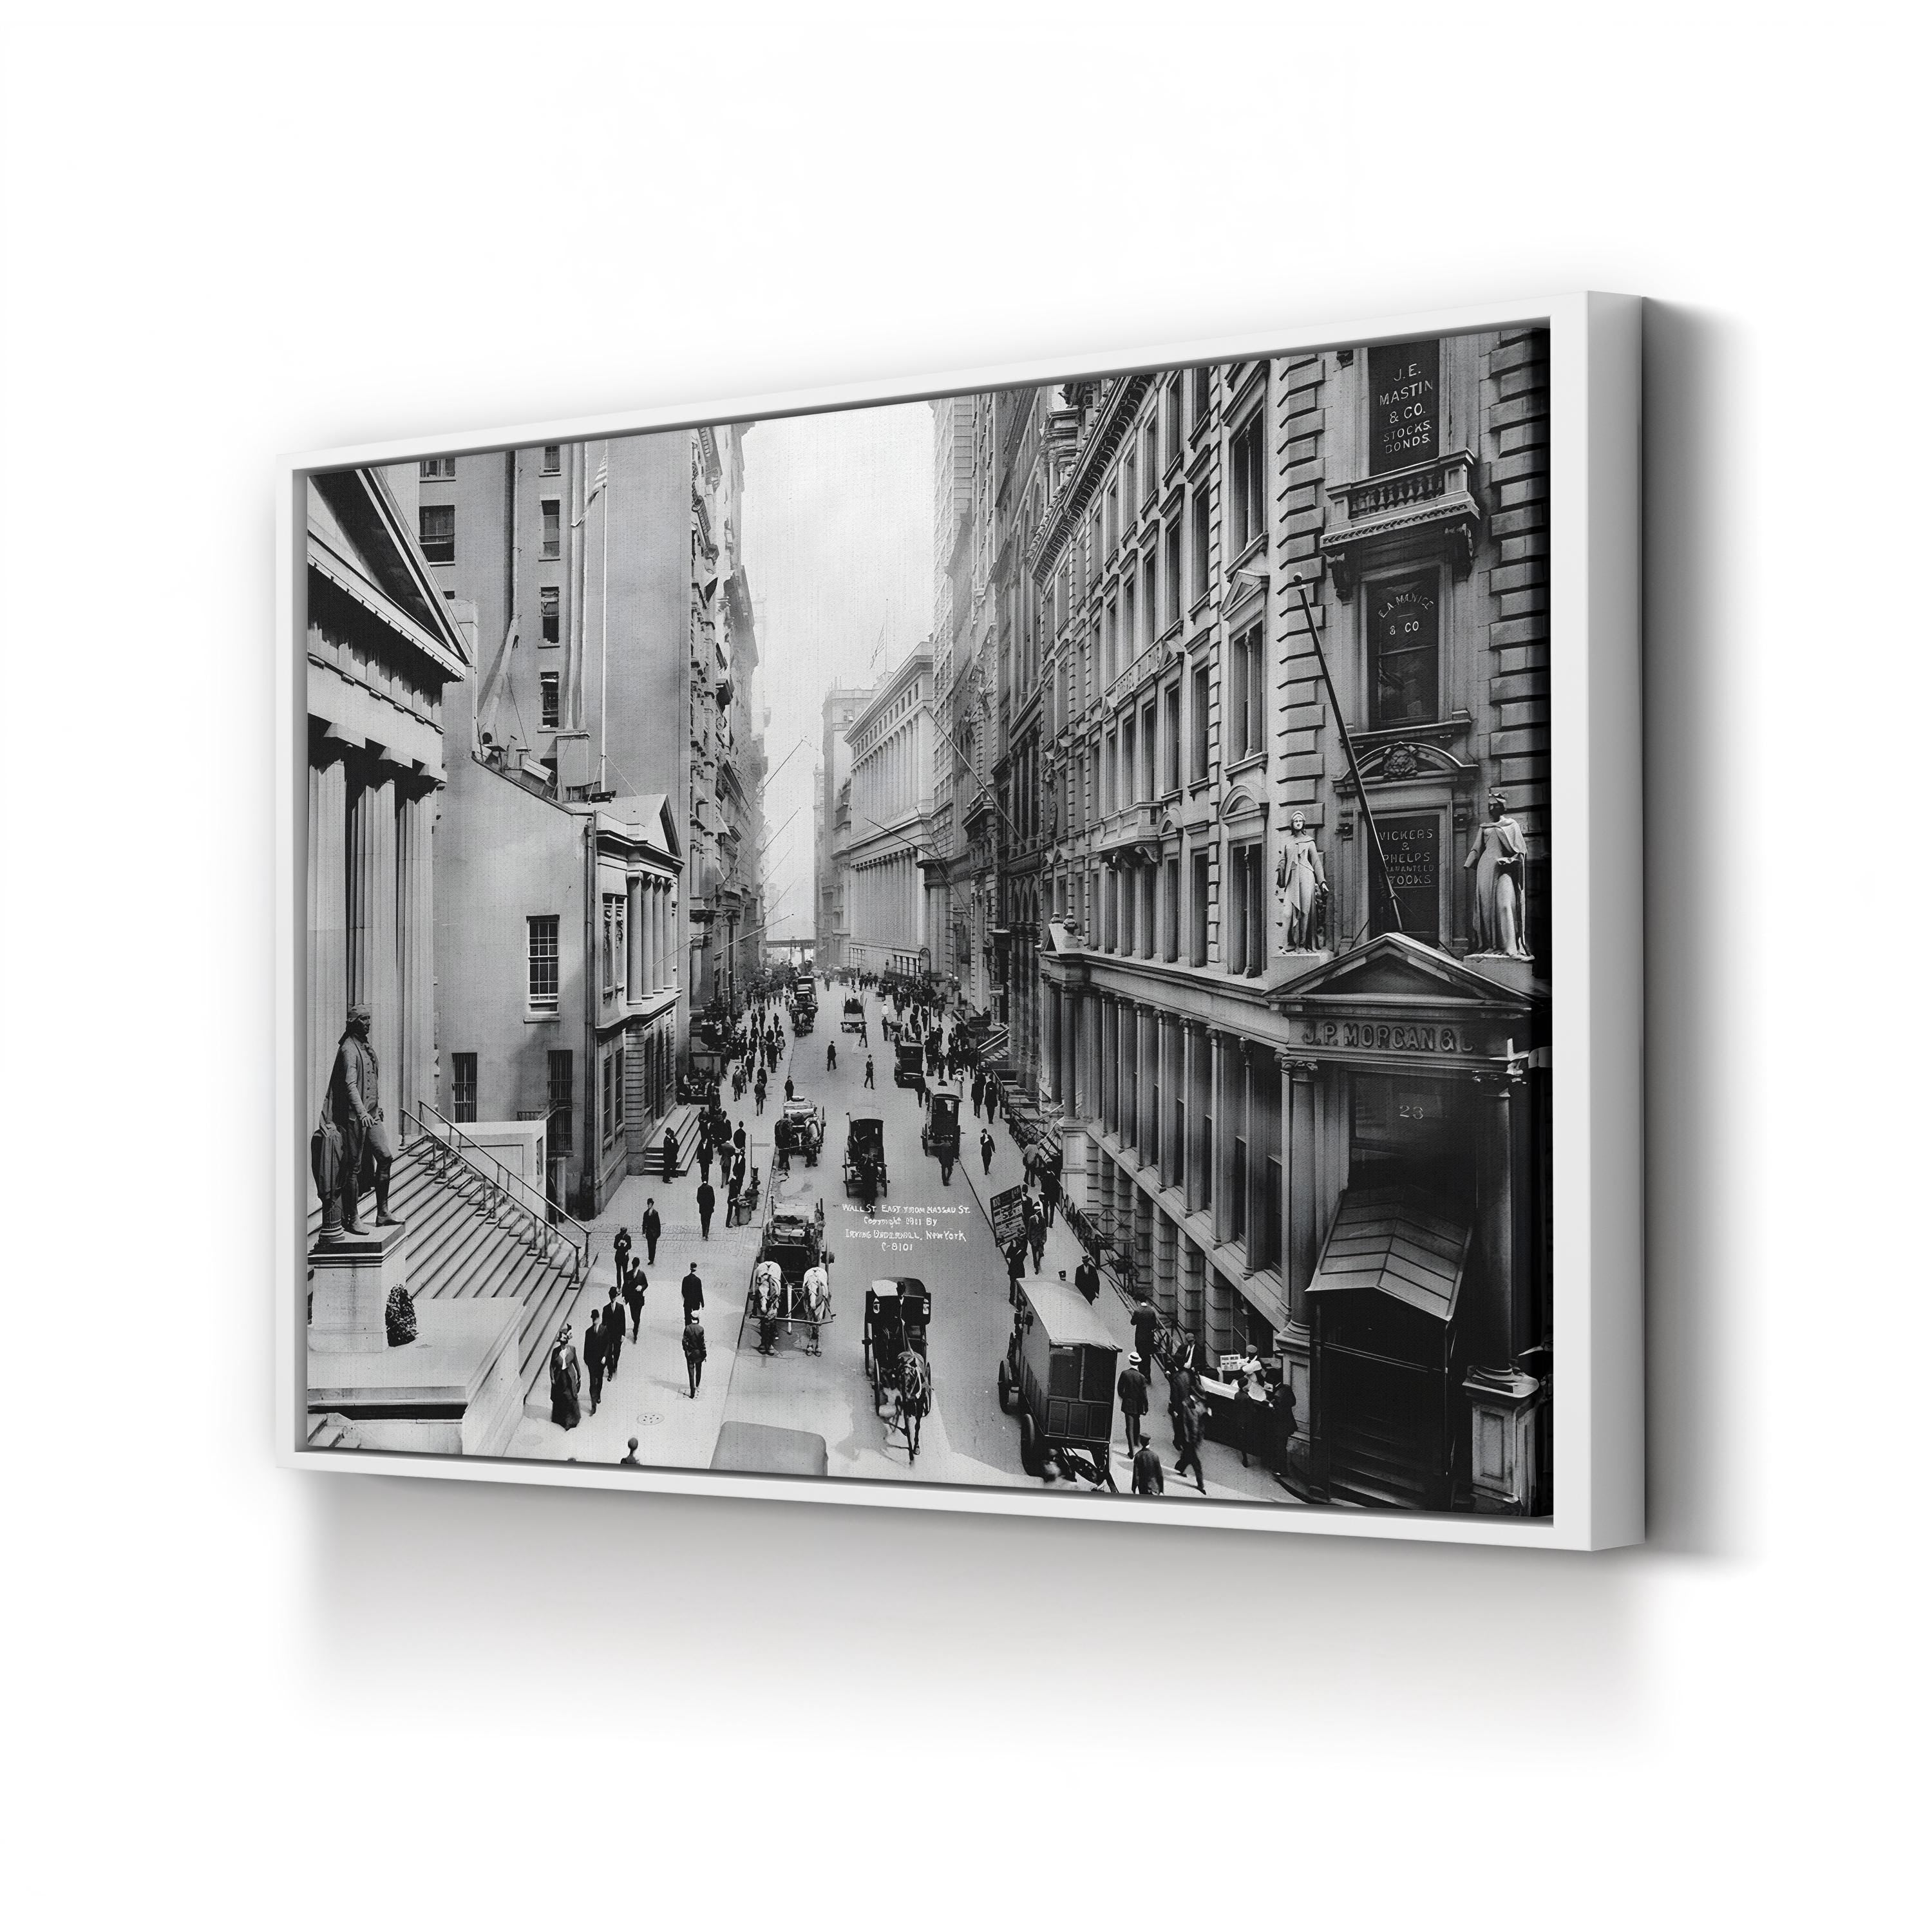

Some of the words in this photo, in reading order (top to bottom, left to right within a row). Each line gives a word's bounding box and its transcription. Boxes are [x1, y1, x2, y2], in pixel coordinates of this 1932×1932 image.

[1379, 379, 1433, 406] MASTIN
[1390, 411, 1399, 424] &
[1404, 402, 1426, 419] CO.
[1399, 1104, 1424, 1120] 23
